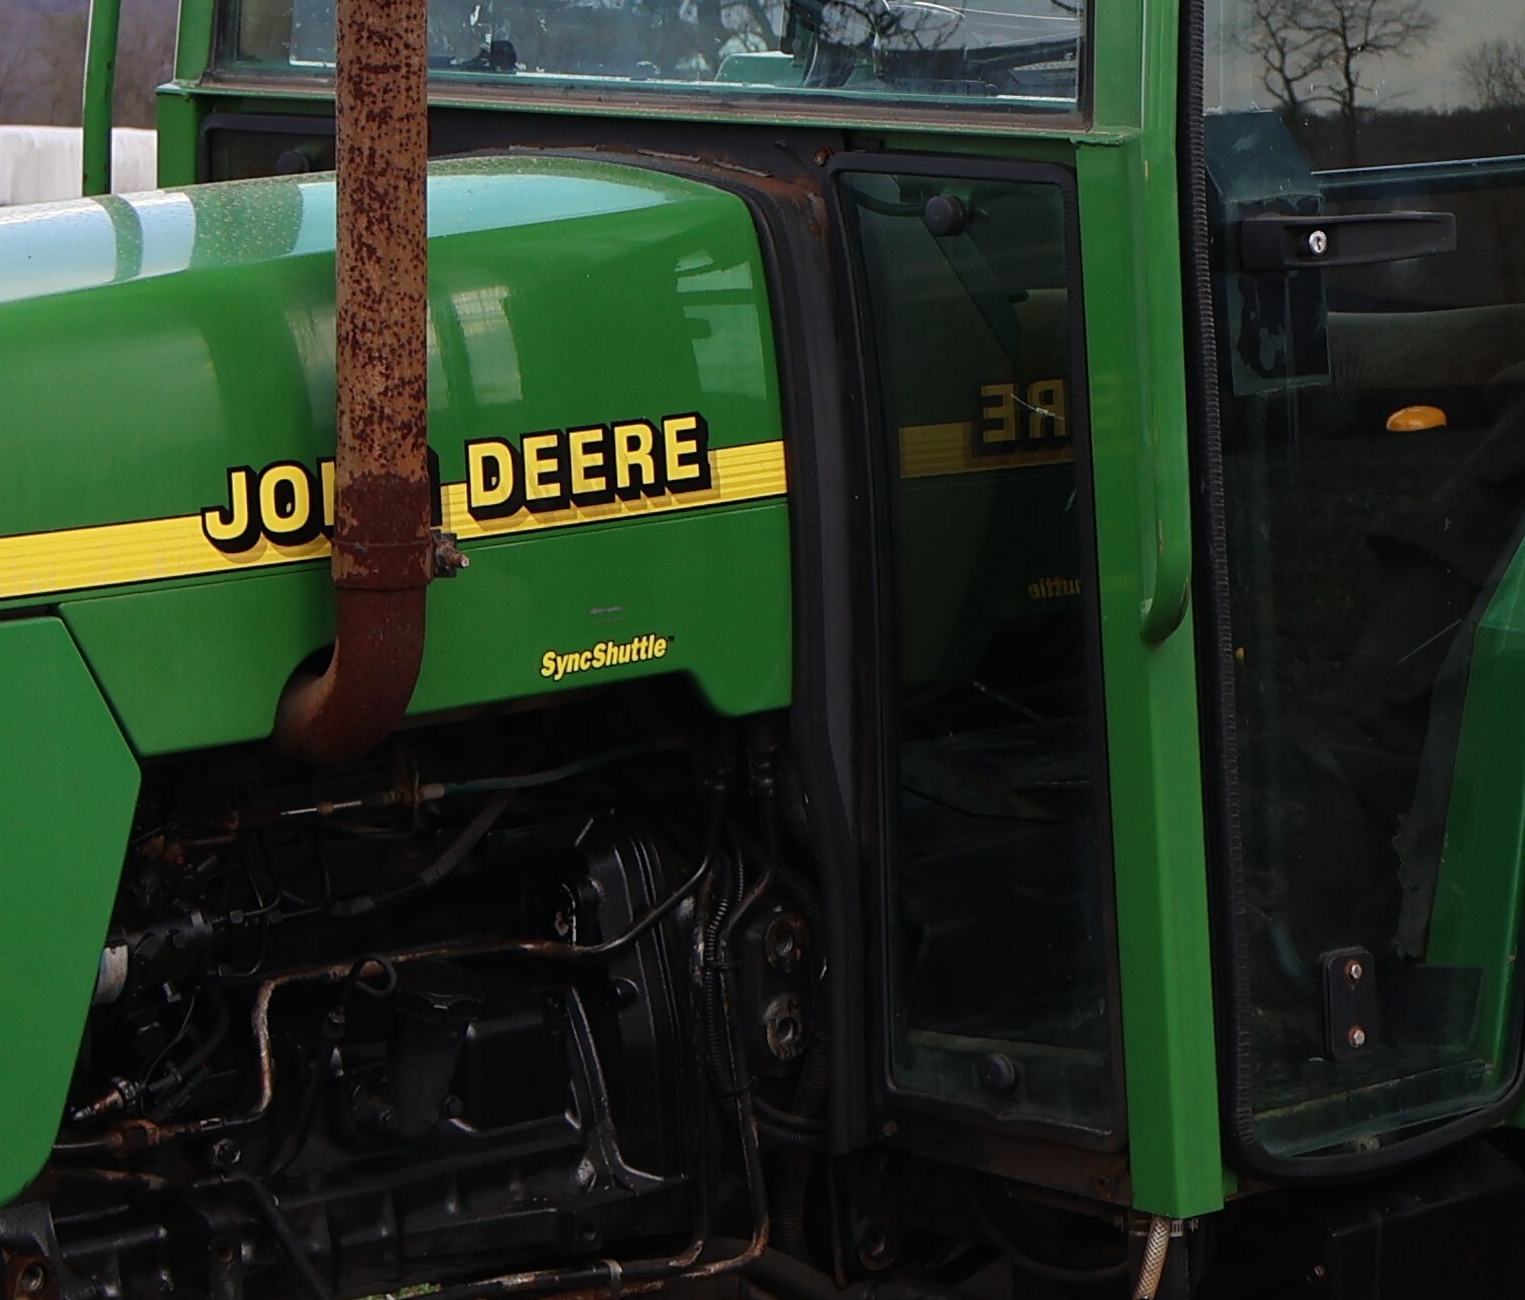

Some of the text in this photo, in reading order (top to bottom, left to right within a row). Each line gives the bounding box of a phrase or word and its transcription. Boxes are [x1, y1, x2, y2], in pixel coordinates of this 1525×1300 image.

[202, 414, 706, 549] JO DEERE
[540, 634, 668, 682] SyncShuttle
